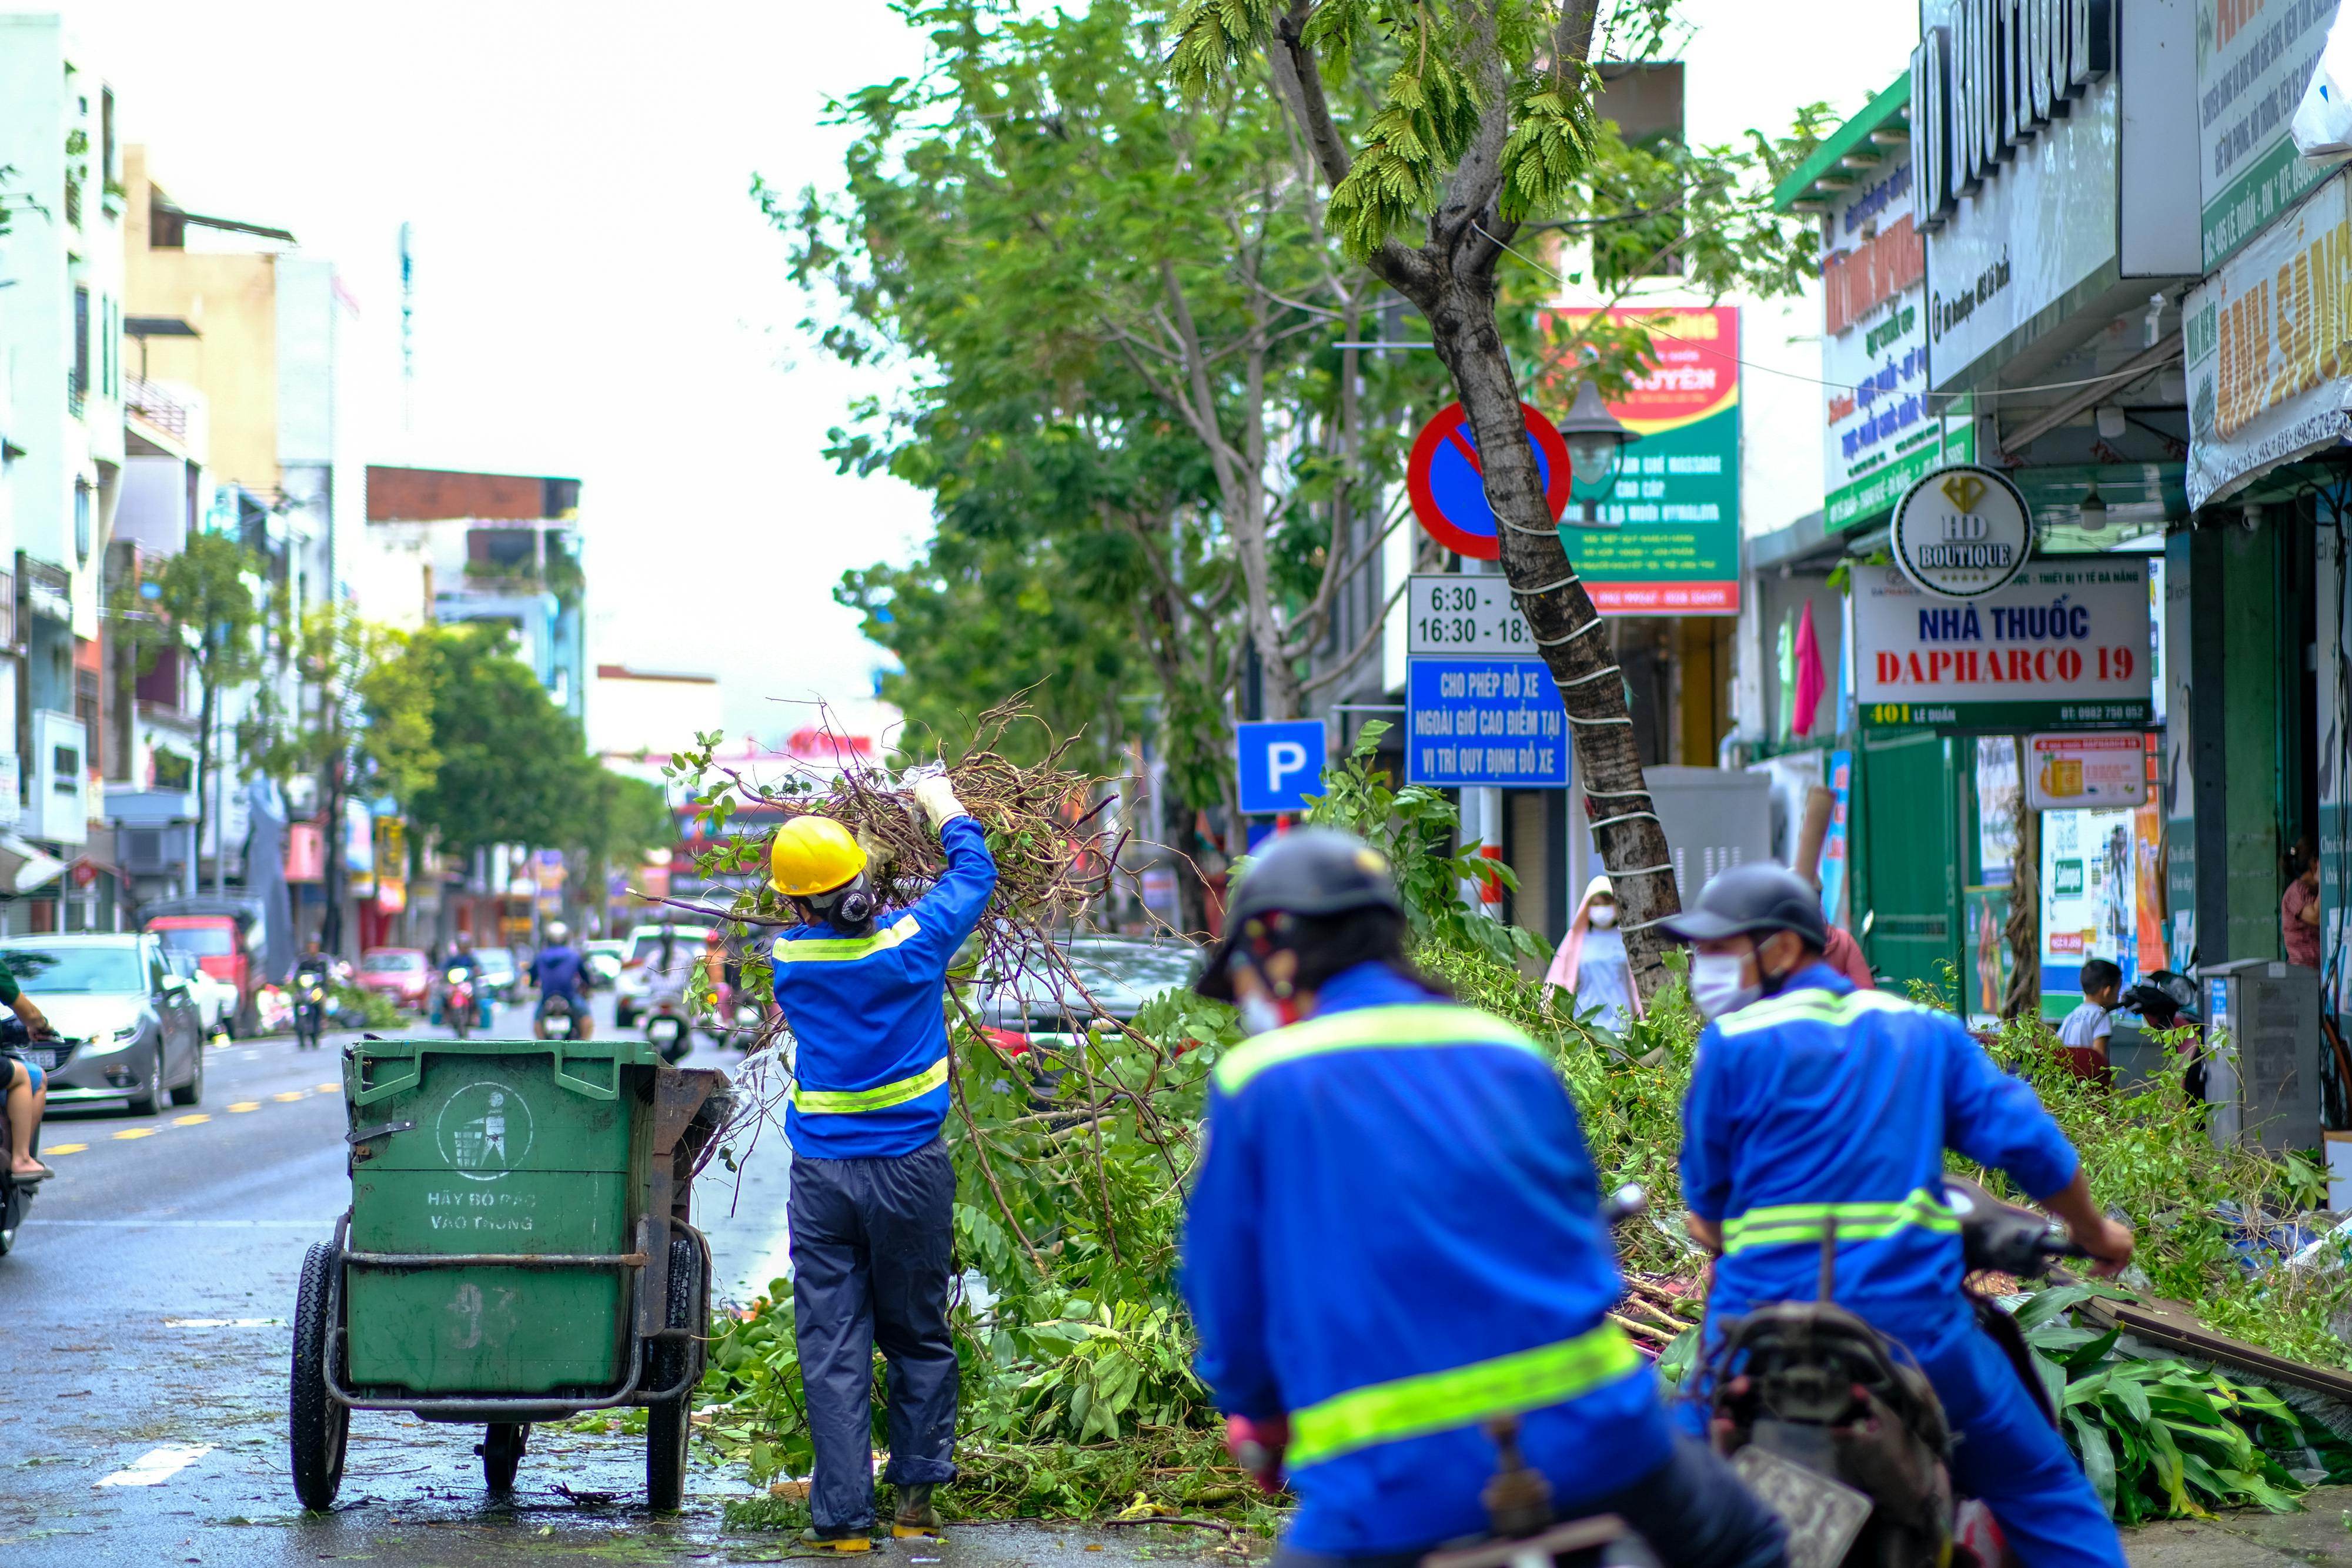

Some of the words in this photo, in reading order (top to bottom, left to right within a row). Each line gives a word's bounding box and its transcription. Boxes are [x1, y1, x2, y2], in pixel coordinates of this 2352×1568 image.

[2227, 203, 2237, 246] LÊ
[1942, 514, 1987, 541] HD
[1919, 544, 2010, 570] BOUTIQUE
[2077, 572, 2083, 584] Y
[1431, 587, 1477, 612] 6:30
[1418, 618, 1476, 643] 16:30
[1498, 618, 1529, 643] 18:
[1919, 601, 1982, 641] NHÀ
[1990, 593, 2090, 640] THUỐC
[1875, 648, 2083, 685] DAPHARCO
[2096, 646, 2134, 682] 19
[1441, 672, 1466, 698] CHO
[1468, 667, 1501, 698] PHÉP
[1523, 673, 1539, 698] XE
[1415, 704, 1453, 735] NGOÀI
[1456, 704, 1477, 735] GIỜ
[1480, 710, 1504, 735] CAO
[1506, 699, 1538, 735] ĐIỂM
[1541, 710, 1560, 741] TẠI
[1869, 703, 1910, 724] 401
[1267, 741, 1307, 793] P
[1422, 748, 1435, 778] VỊ
[1438, 743, 1457, 773] TRÍ
[1459, 748, 1484, 776] QUY
[1486, 748, 1516, 778] ĐỊNH
[1538, 748, 1555, 773] XE
[428, 1189, 463, 1206] HÃY
[469, 1189, 495, 1206] BỎ
[430, 1212, 467, 1229] VÀO
